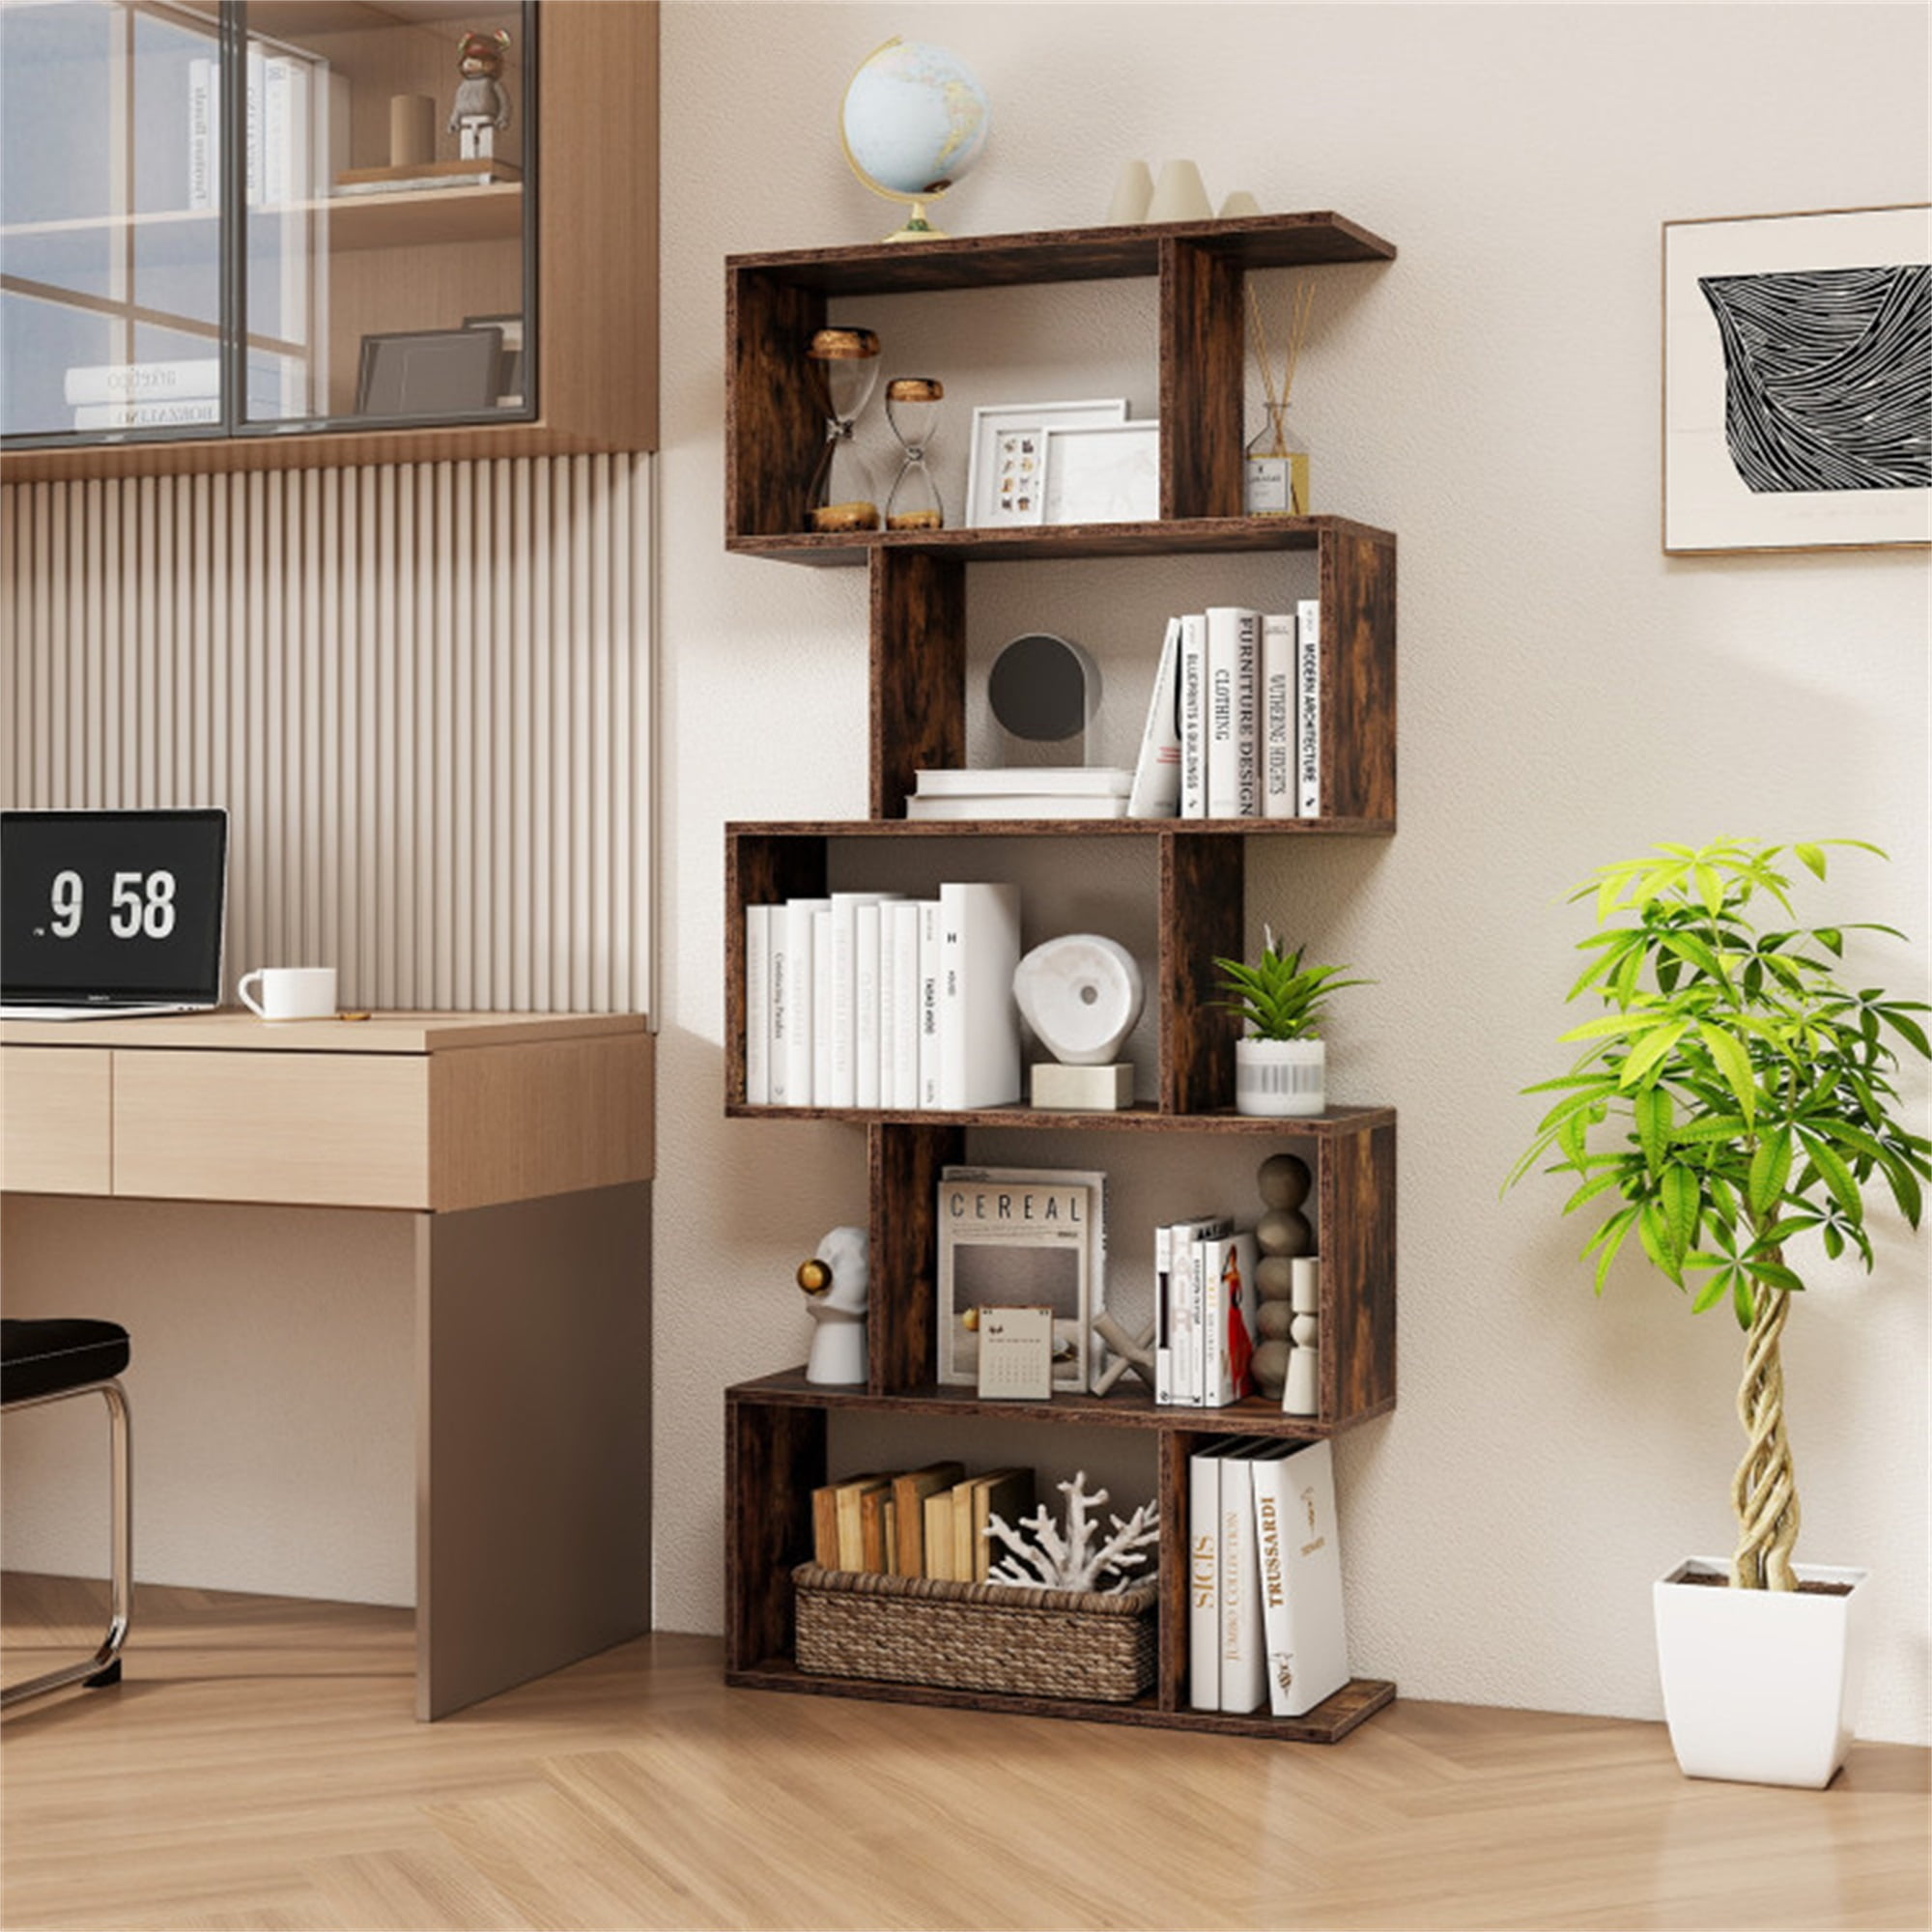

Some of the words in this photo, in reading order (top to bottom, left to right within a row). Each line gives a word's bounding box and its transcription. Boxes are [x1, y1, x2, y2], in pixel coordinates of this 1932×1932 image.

[1186, 653, 1199, 720] BLUEPRINTS
[1239, 617, 1254, 737] FURNITURE
[1303, 643, 1317, 695] MODERN
[1187, 721, 1198, 730] &
[1215, 668, 1230, 742] CLOTHING
[1269, 674, 1286, 743] WUTHERING
[1303, 696, 1317, 781] ARCHITECTURE
[1186, 732, 1199, 789] BUILDINGS
[1239, 741, 1254, 817] DESIGN
[51, 870, 83, 939] 9
[109, 870, 176, 939] 58
[950, 1191, 1082, 1222] CEREAL
[1225, 1512, 1238, 1606] COLLECTION
[1261, 1497, 1284, 1608] TRUSSARDI
[1225, 1608, 1240, 1662] JUMBO
